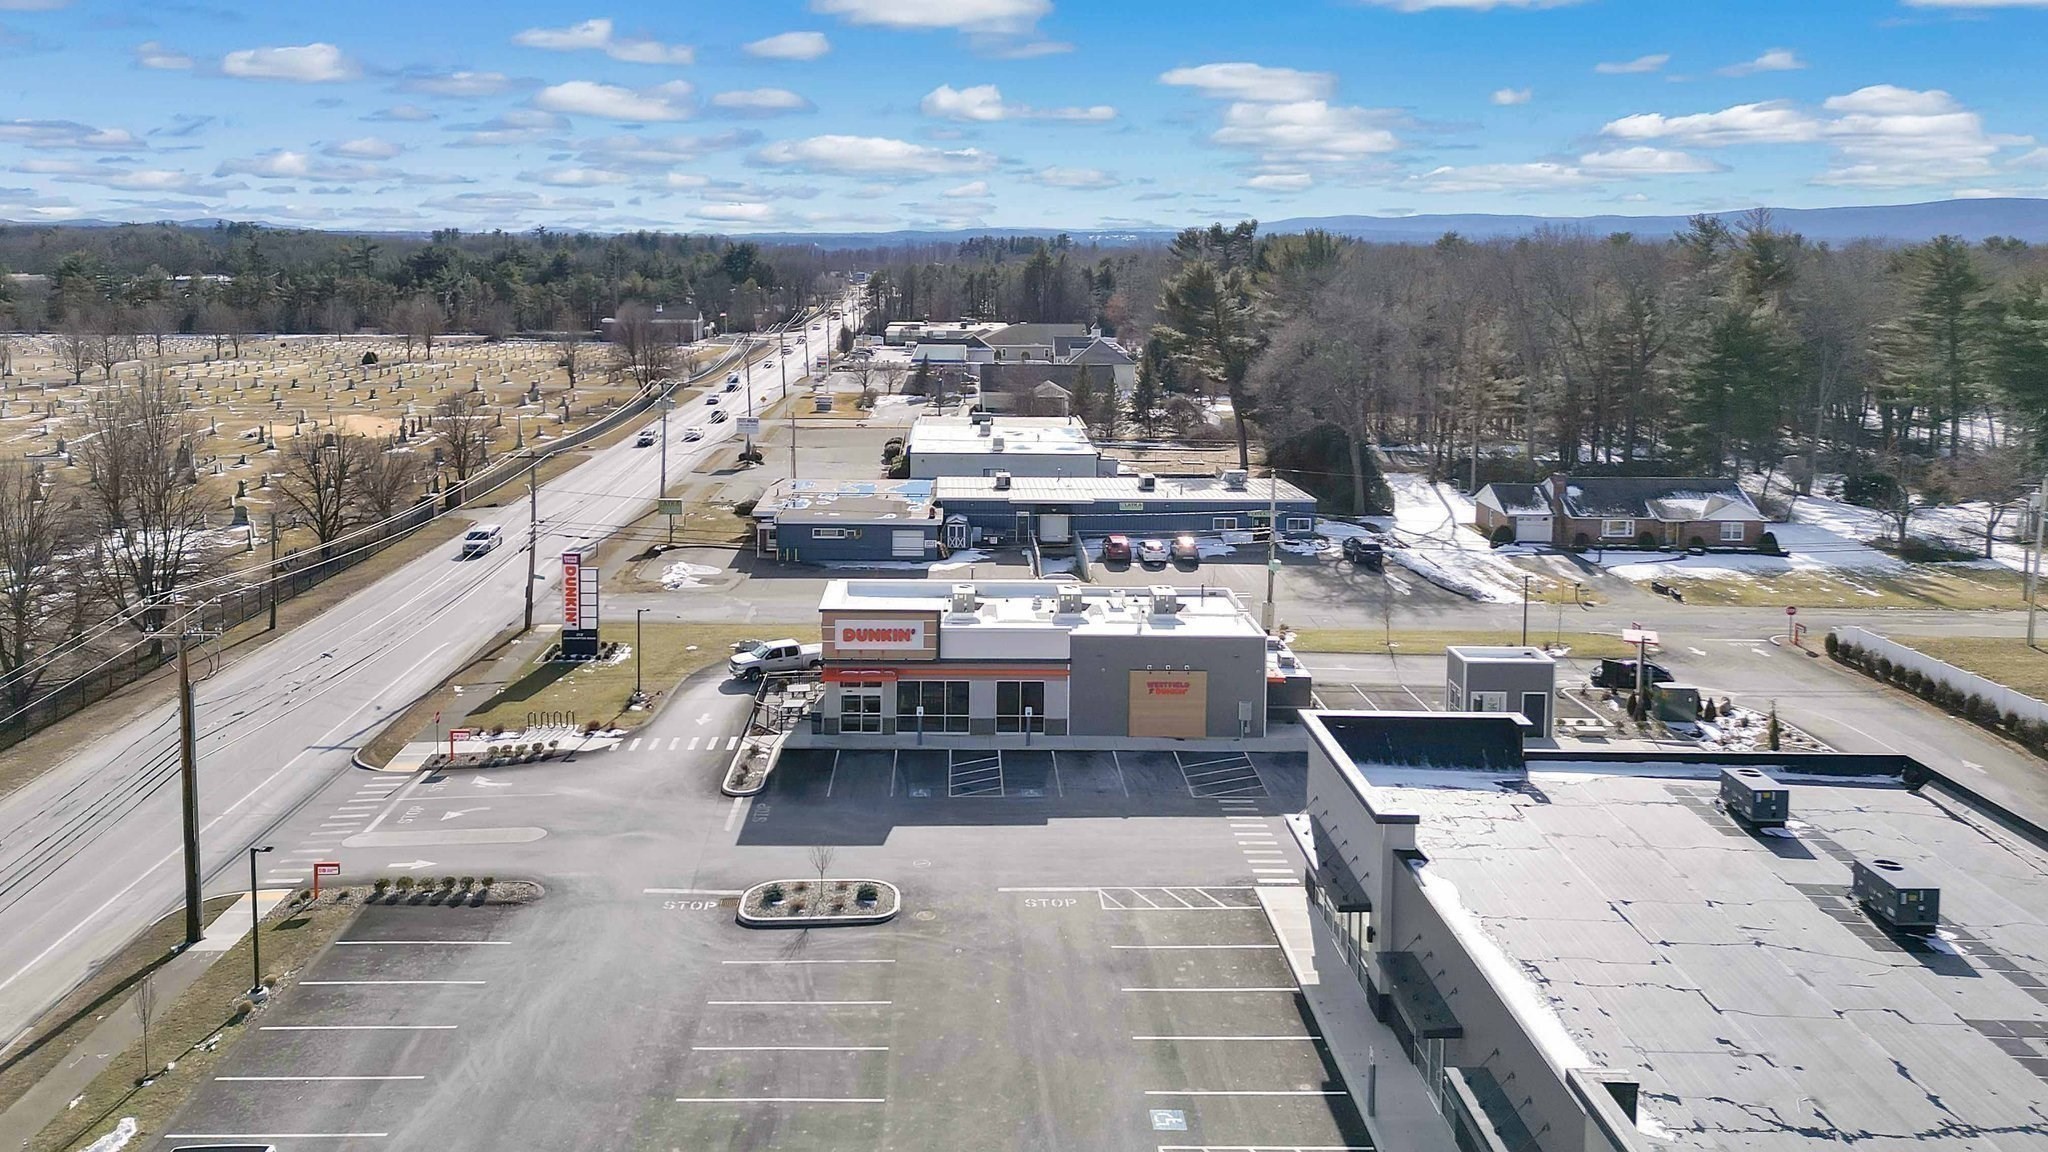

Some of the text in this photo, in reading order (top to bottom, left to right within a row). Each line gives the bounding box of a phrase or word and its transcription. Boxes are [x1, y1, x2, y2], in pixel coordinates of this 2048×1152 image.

[564, 566, 578, 627] DUNKIN'
[842, 627, 916, 642] DUNKIN'
[396, 804, 426, 824] STOP
[752, 803, 772, 823] STOP
[662, 900, 718, 911] STOP
[1024, 898, 1077, 908] STOP
